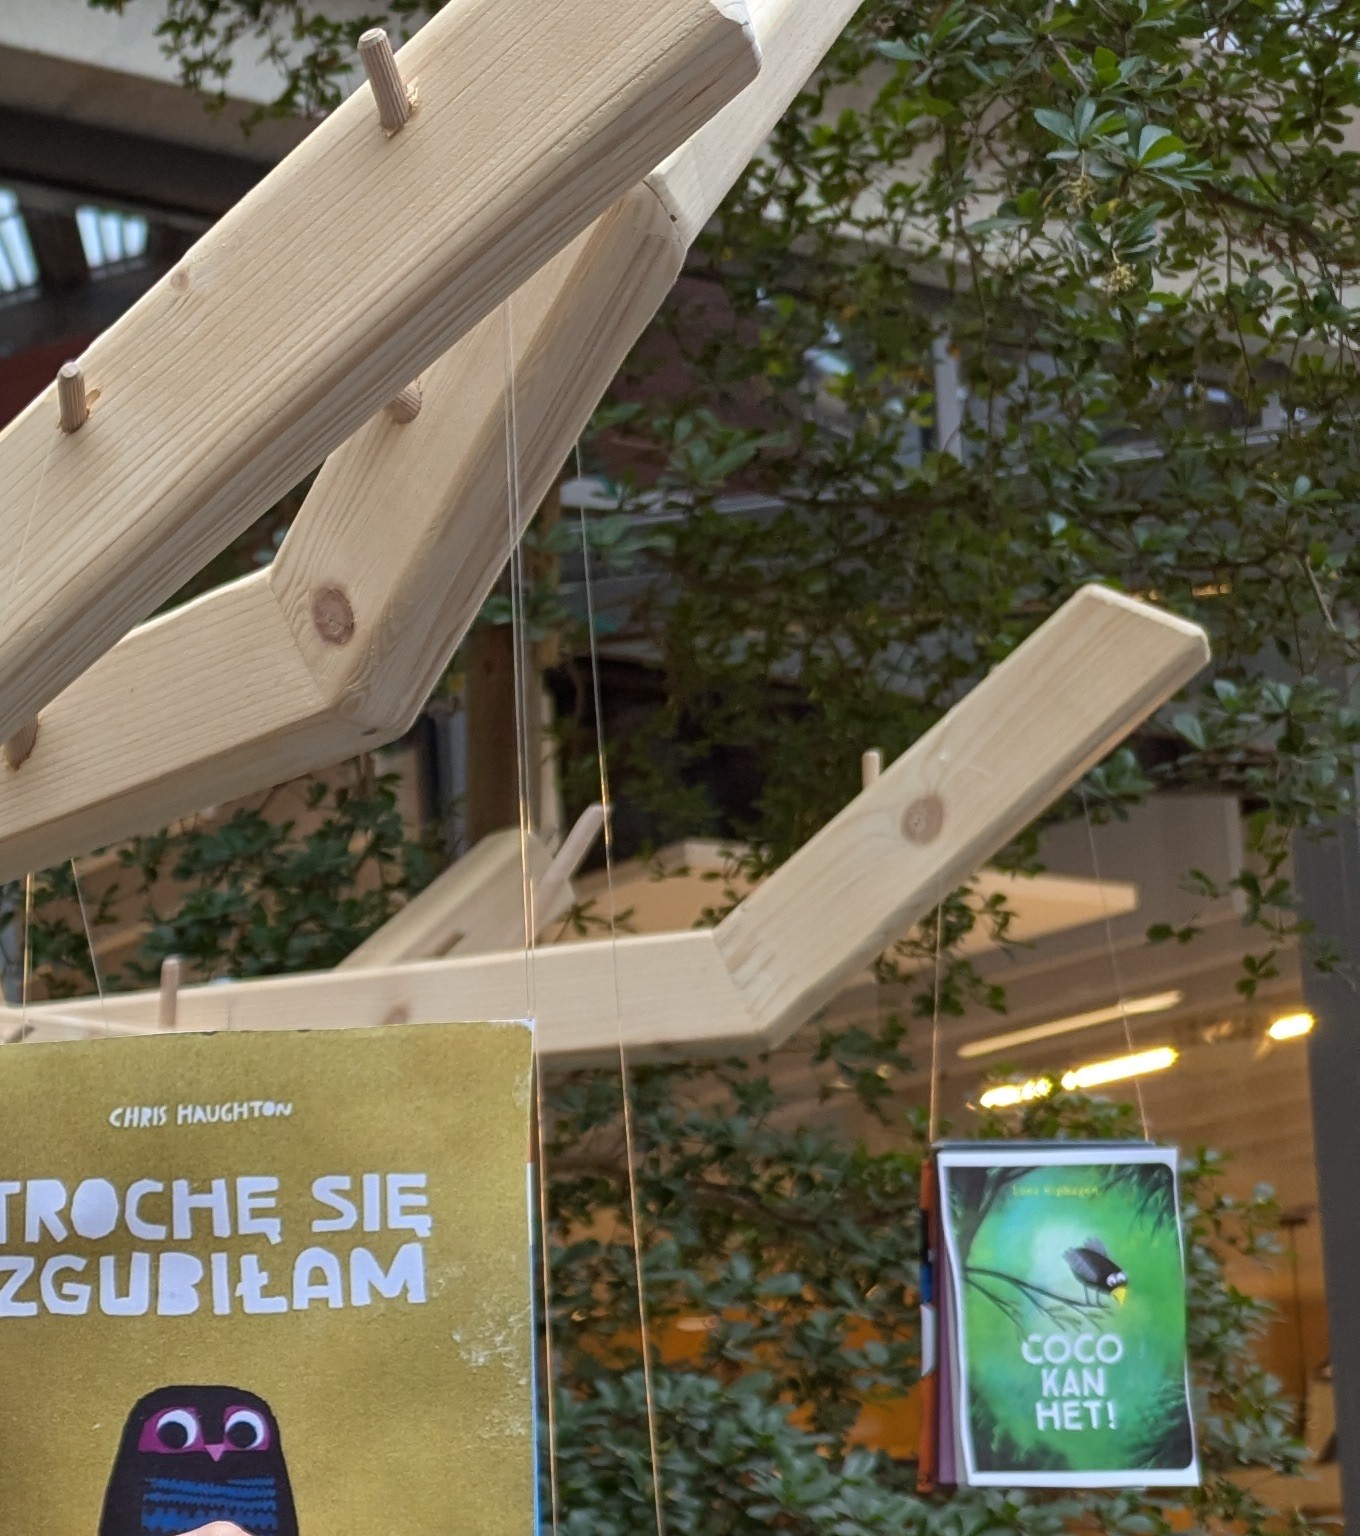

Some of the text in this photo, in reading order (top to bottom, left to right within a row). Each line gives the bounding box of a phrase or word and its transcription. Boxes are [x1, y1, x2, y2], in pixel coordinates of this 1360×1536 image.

[108, 1100, 293, 1128] CHRIS HAUGHTON
[310, 1172, 433, 1238] SIĘ
[1021, 1332, 1124, 1365] COCO
[1041, 1366, 1107, 1398] KAN
[1034, 1400, 1119, 1431] HET!
